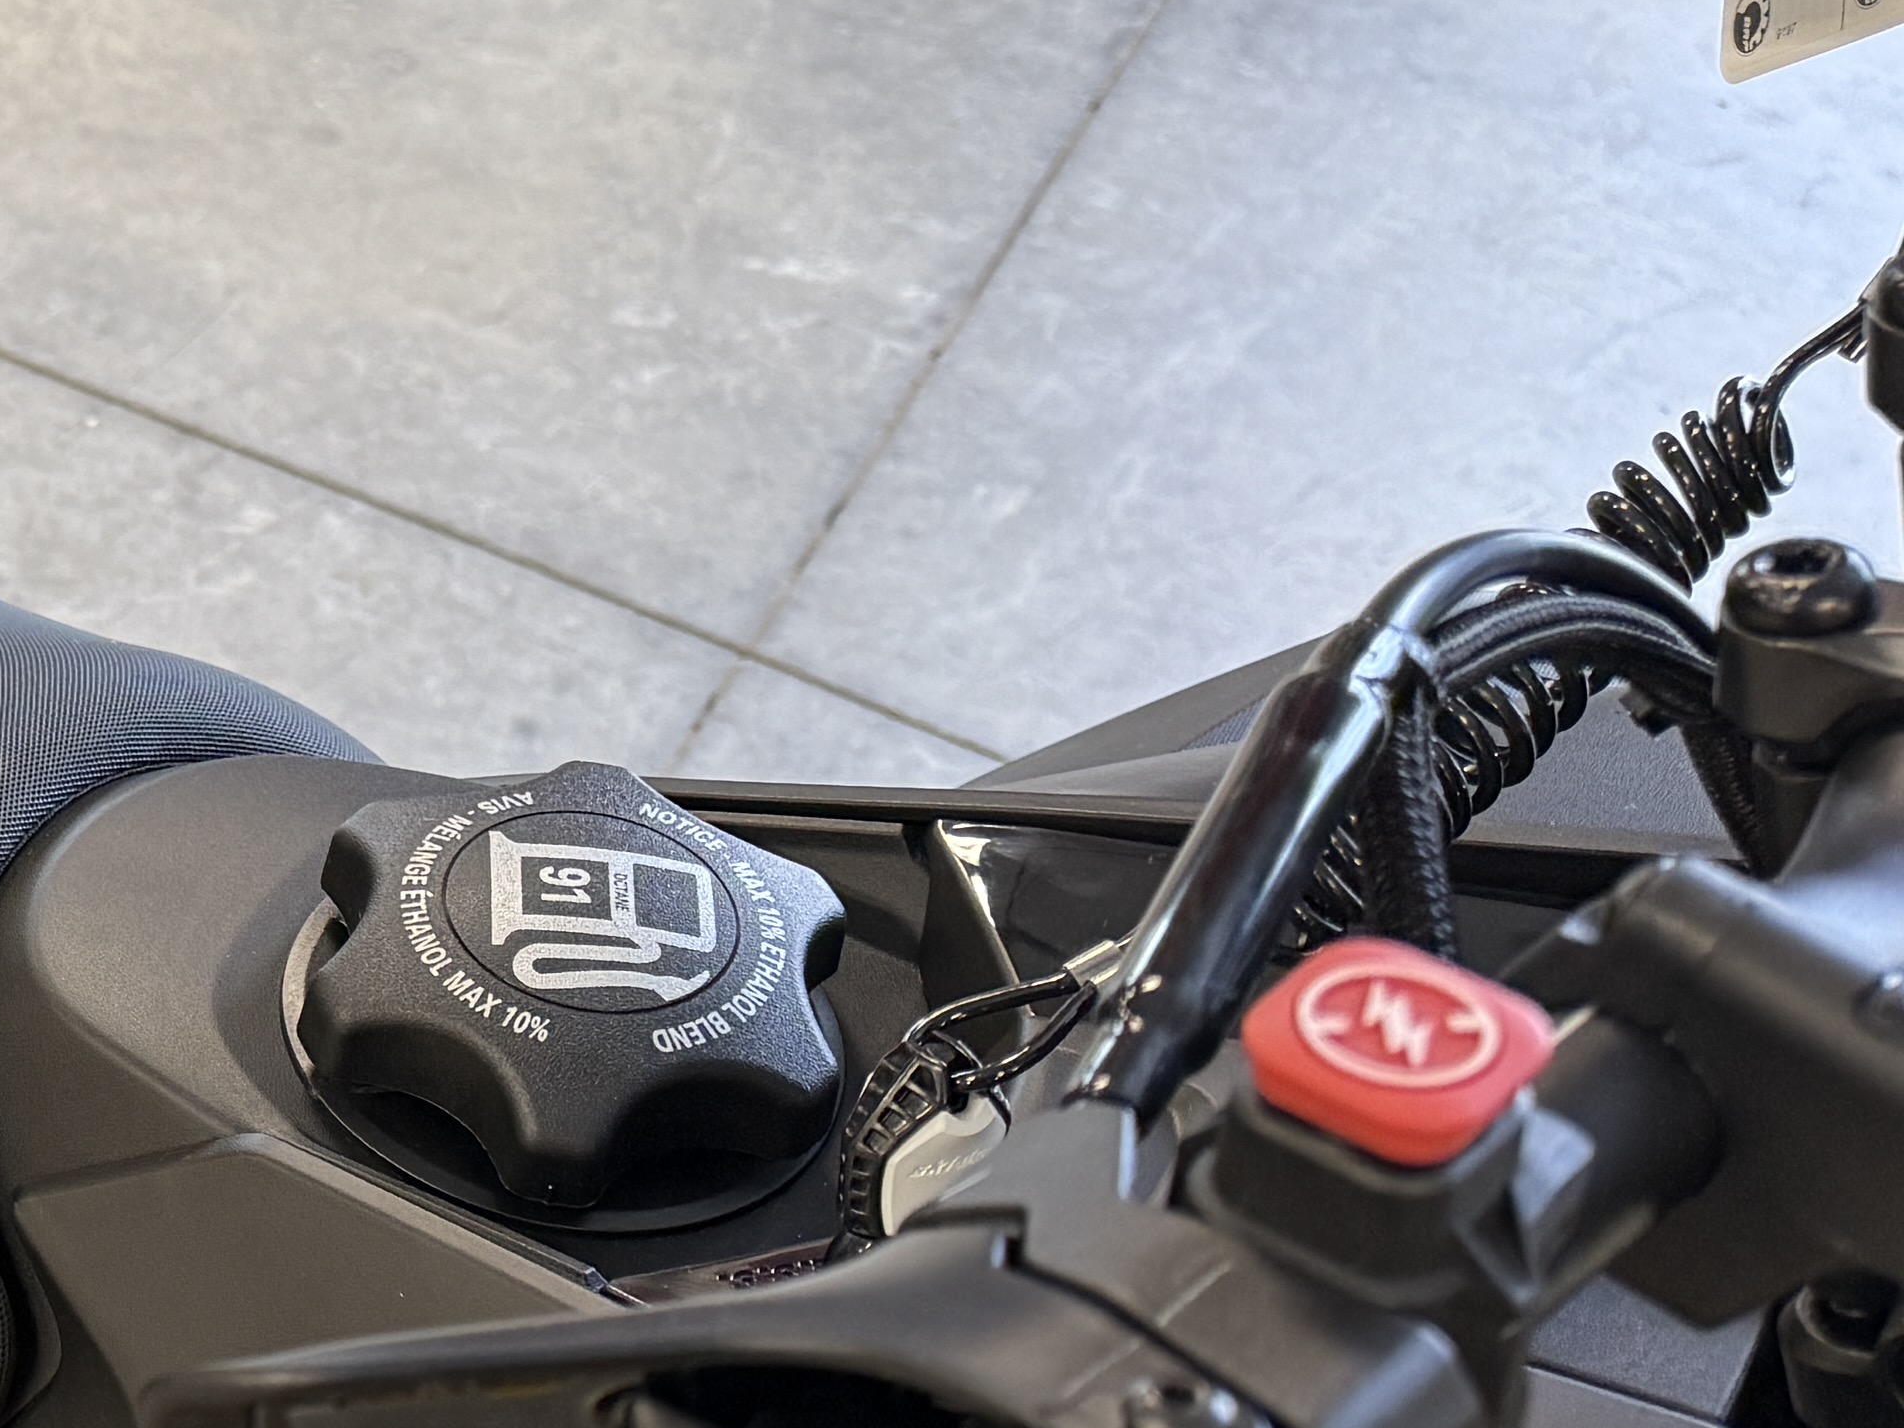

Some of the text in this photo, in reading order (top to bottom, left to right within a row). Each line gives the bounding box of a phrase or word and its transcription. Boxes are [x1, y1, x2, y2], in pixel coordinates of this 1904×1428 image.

[477, 791, 534, 815] AVIS
[639, 803, 727, 852] NOTICE
[401, 814, 474, 886] MÉLANGE
[539, 866, 592, 904] 91
[613, 873, 630, 912] OCTANE
[729, 860, 775, 904] MAX
[400, 890, 453, 977] ÉTHANOL
[758, 907, 786, 942] 10%
[442, 970, 502, 1018] MAX
[721, 942, 786, 1023] ETHANOL
[501, 1007, 551, 1042] 10%
[652, 1010, 731, 1053] BLEND
